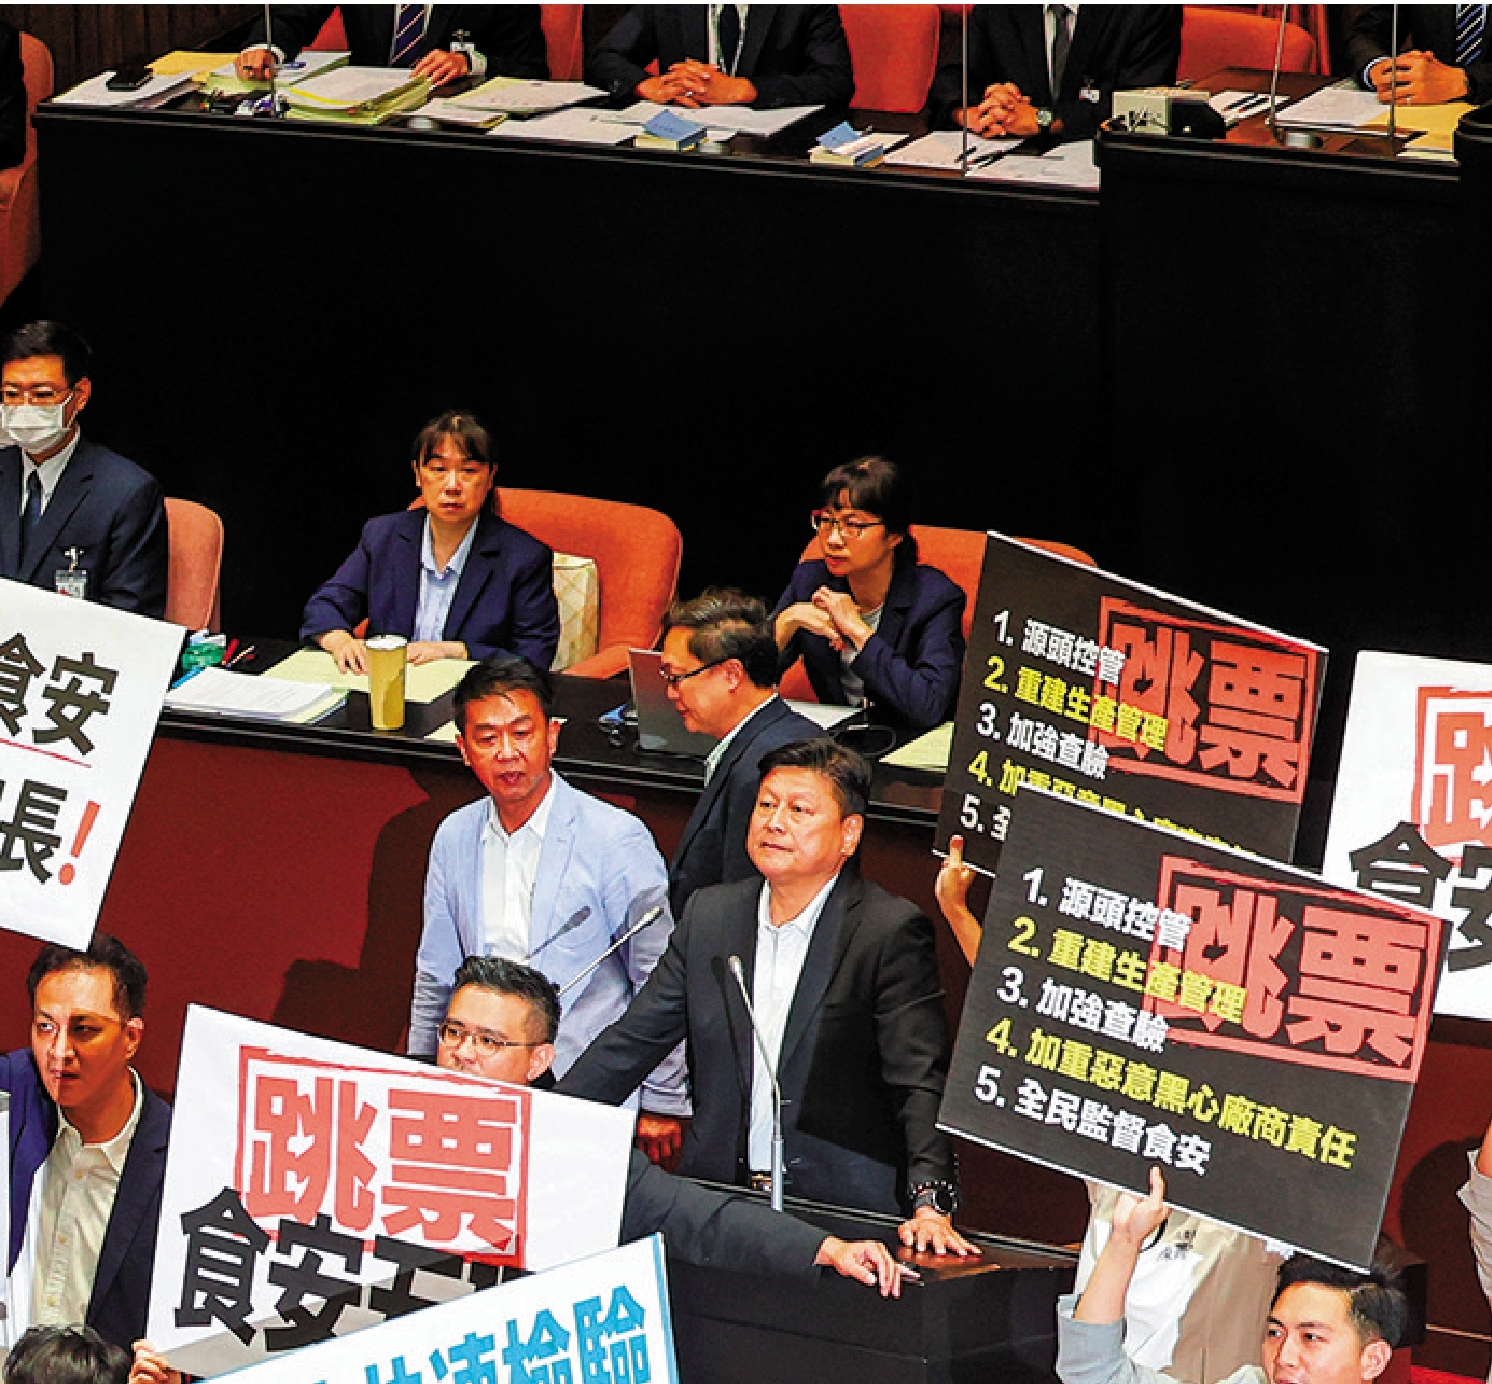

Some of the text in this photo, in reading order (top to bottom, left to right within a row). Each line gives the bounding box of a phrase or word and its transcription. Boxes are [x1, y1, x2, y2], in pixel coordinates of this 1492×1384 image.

[993, 611, 1126, 684] 1. 源頭控管
[976, 702, 1110, 779] 3. 加強查驗
[984, 656, 1168, 751] 2. 重建生產管理
[1099, 622, 1308, 787] 跳票
[960, 794, 985, 833] 5.
[968, 751, 994, 787] 4.
[1022, 868, 1192, 952] 1. 源頭控管
[997, 966, 1170, 1053] 3. 加強查驗
[1007, 916, 1247, 1025] 2. 重建生產管理
[1152, 884, 1426, 1066] 跳票
[974, 1066, 1213, 1177] 5. 全民監督食安
[986, 1017, 1359, 1171] 4. 加重惡意黑心廠商責任
[246, 1076, 516, 1251] 跳票
